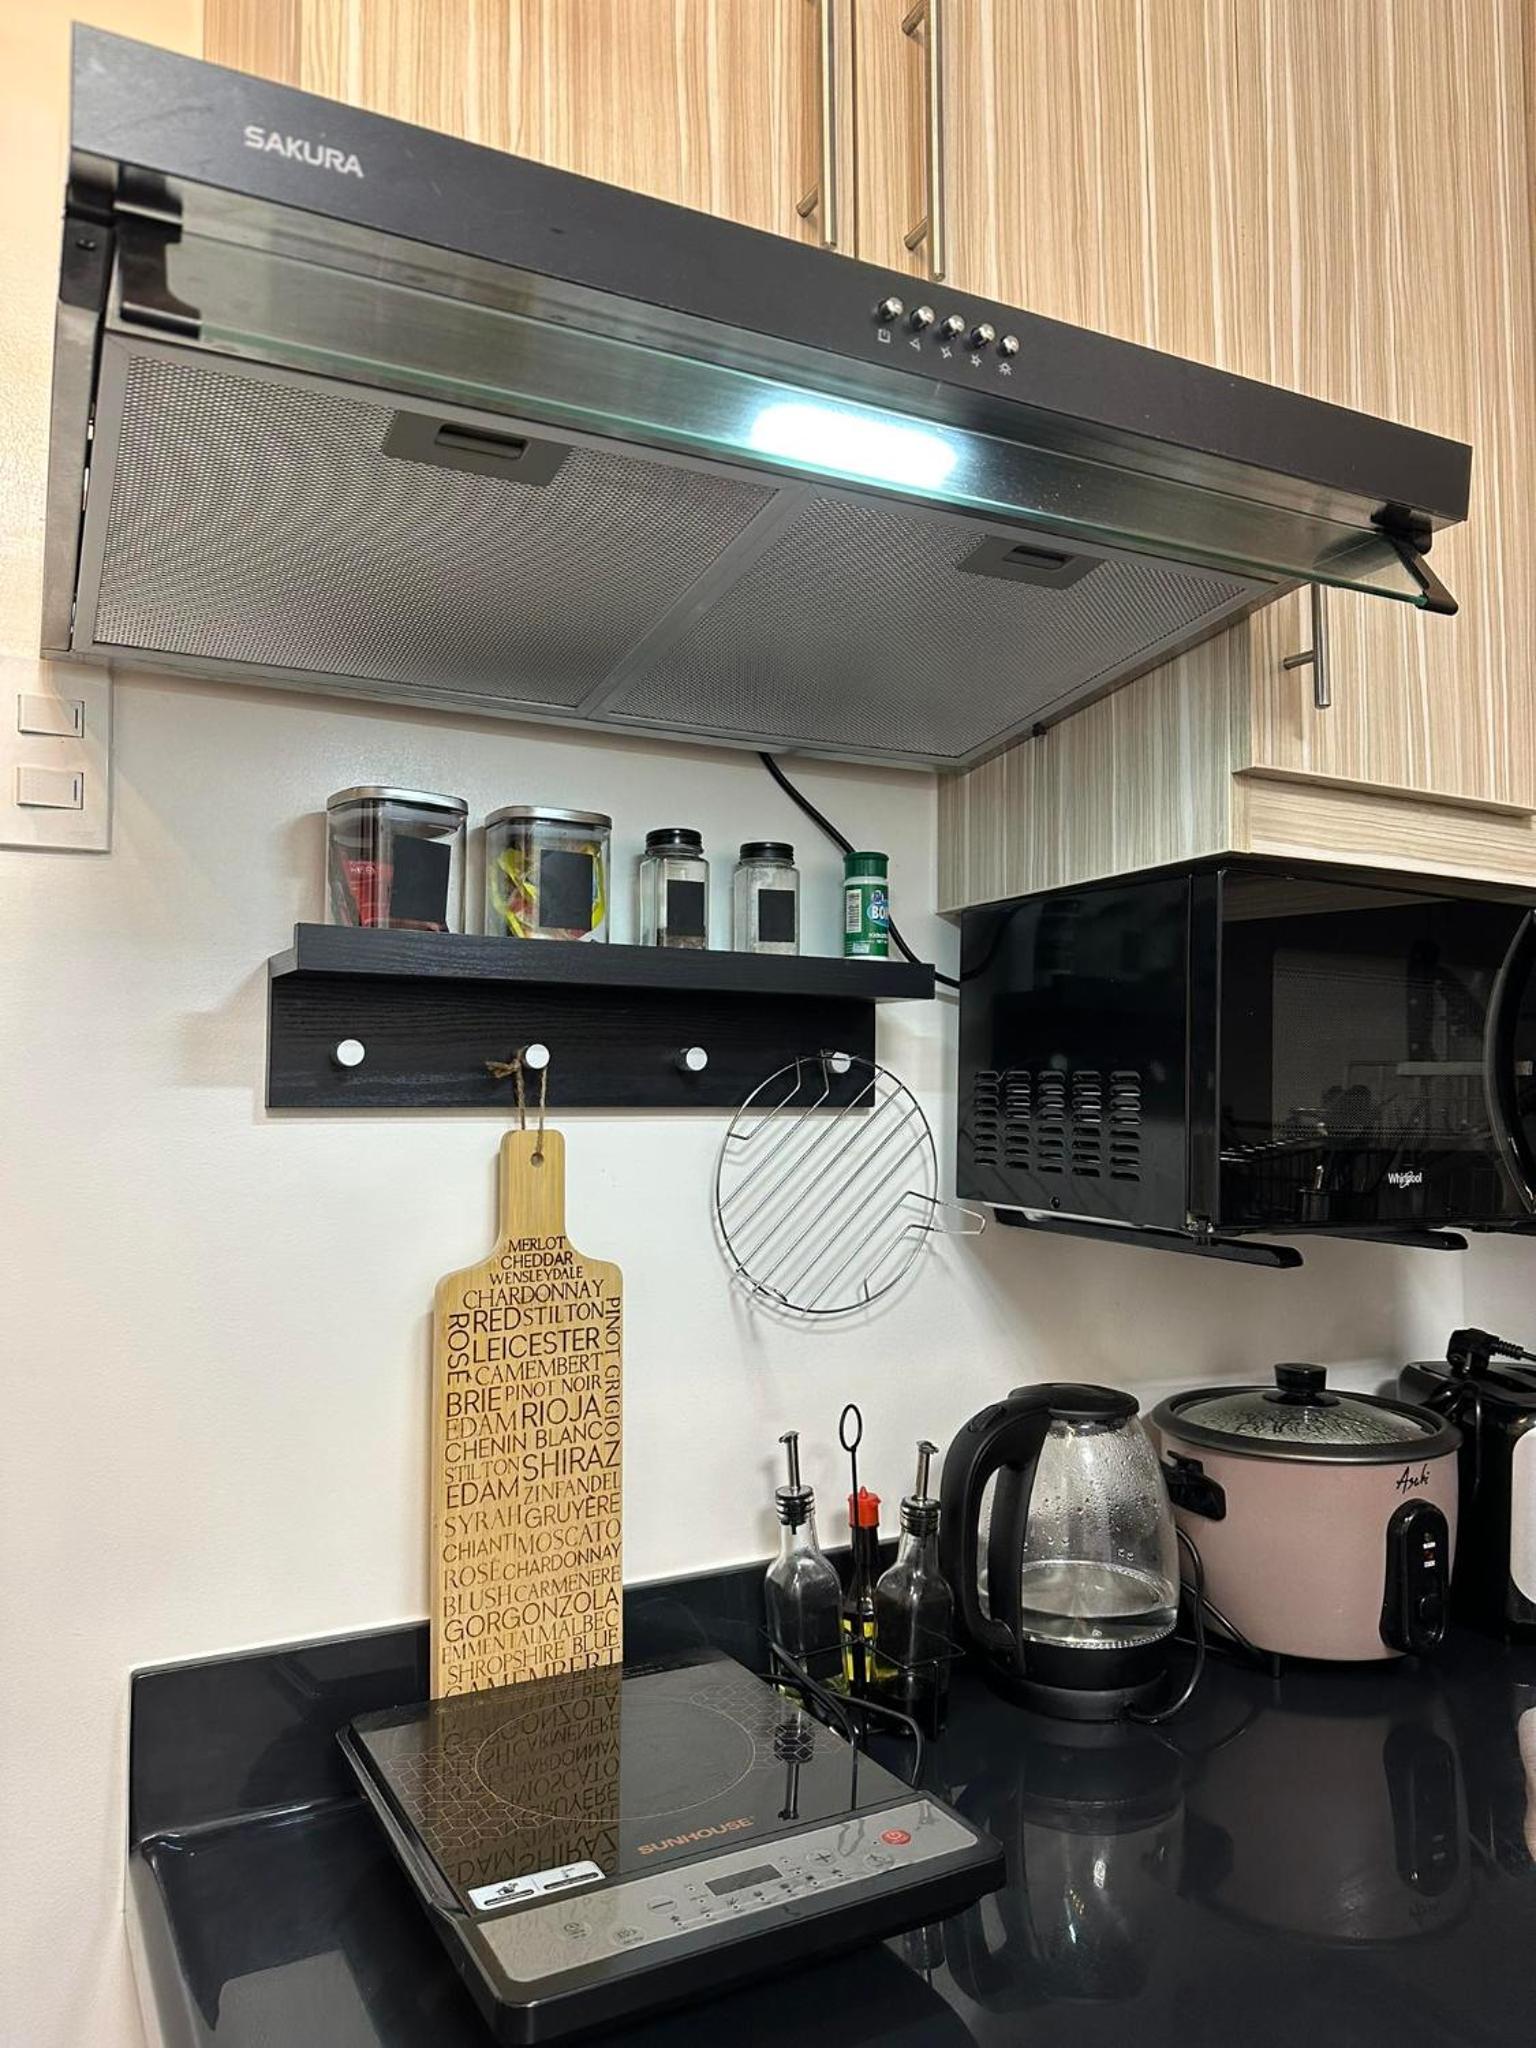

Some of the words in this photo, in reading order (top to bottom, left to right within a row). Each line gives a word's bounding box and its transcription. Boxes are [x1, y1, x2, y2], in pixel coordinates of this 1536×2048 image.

[244, 125, 364, 178] SAKURA
[500, 1251, 573, 1270] CHEDDAR
[508, 1235, 566, 1253] MERLOT
[489, 1266, 583, 1286] WENSLEYDALE
[463, 1279, 605, 1309] CHARDONNAY
[473, 1307, 521, 1334] RED
[523, 1301, 605, 1327] STILTON
[605, 1296, 620, 1358] PINOT
[473, 1326, 600, 1364] LEICESTER
[475, 1352, 604, 1387] CAMEMBERT
[447, 1386, 501, 1418] BRIE
[505, 1380, 556, 1401] PINOT
[562, 1374, 603, 1394] NOIR
[604, 1364, 620, 1437] GRIGIO
[446, 1410, 518, 1442] EDAM
[522, 1393, 602, 1430] RIOJA
[445, 1432, 527, 1463] CHENIN
[535, 1420, 603, 1450] BLANC
[444, 1456, 520, 1485] STILTON
[522, 1441, 621, 1483] SHIRAZ
[446, 1476, 520, 1510] EDAM
[523, 1471, 620, 1506] ZINFANDEL
[444, 1504, 522, 1539] SYRAH
[518, 1518, 622, 1559] MOSCATO
[442, 1532, 517, 1564] CHIANTI
[502, 1542, 622, 1581] CHARDONNAY
[514, 1564, 621, 1602] CARMENERE
[443, 1583, 512, 1619] BLUSH
[444, 1587, 620, 1644] GORGONZOLA
[539, 1608, 619, 1645] MALBEC
[448, 1640, 566, 1686] SHROPSHIRE
[572, 1627, 619, 1656] BLUE
[638, 1817, 754, 1855] SUNHOUSE
